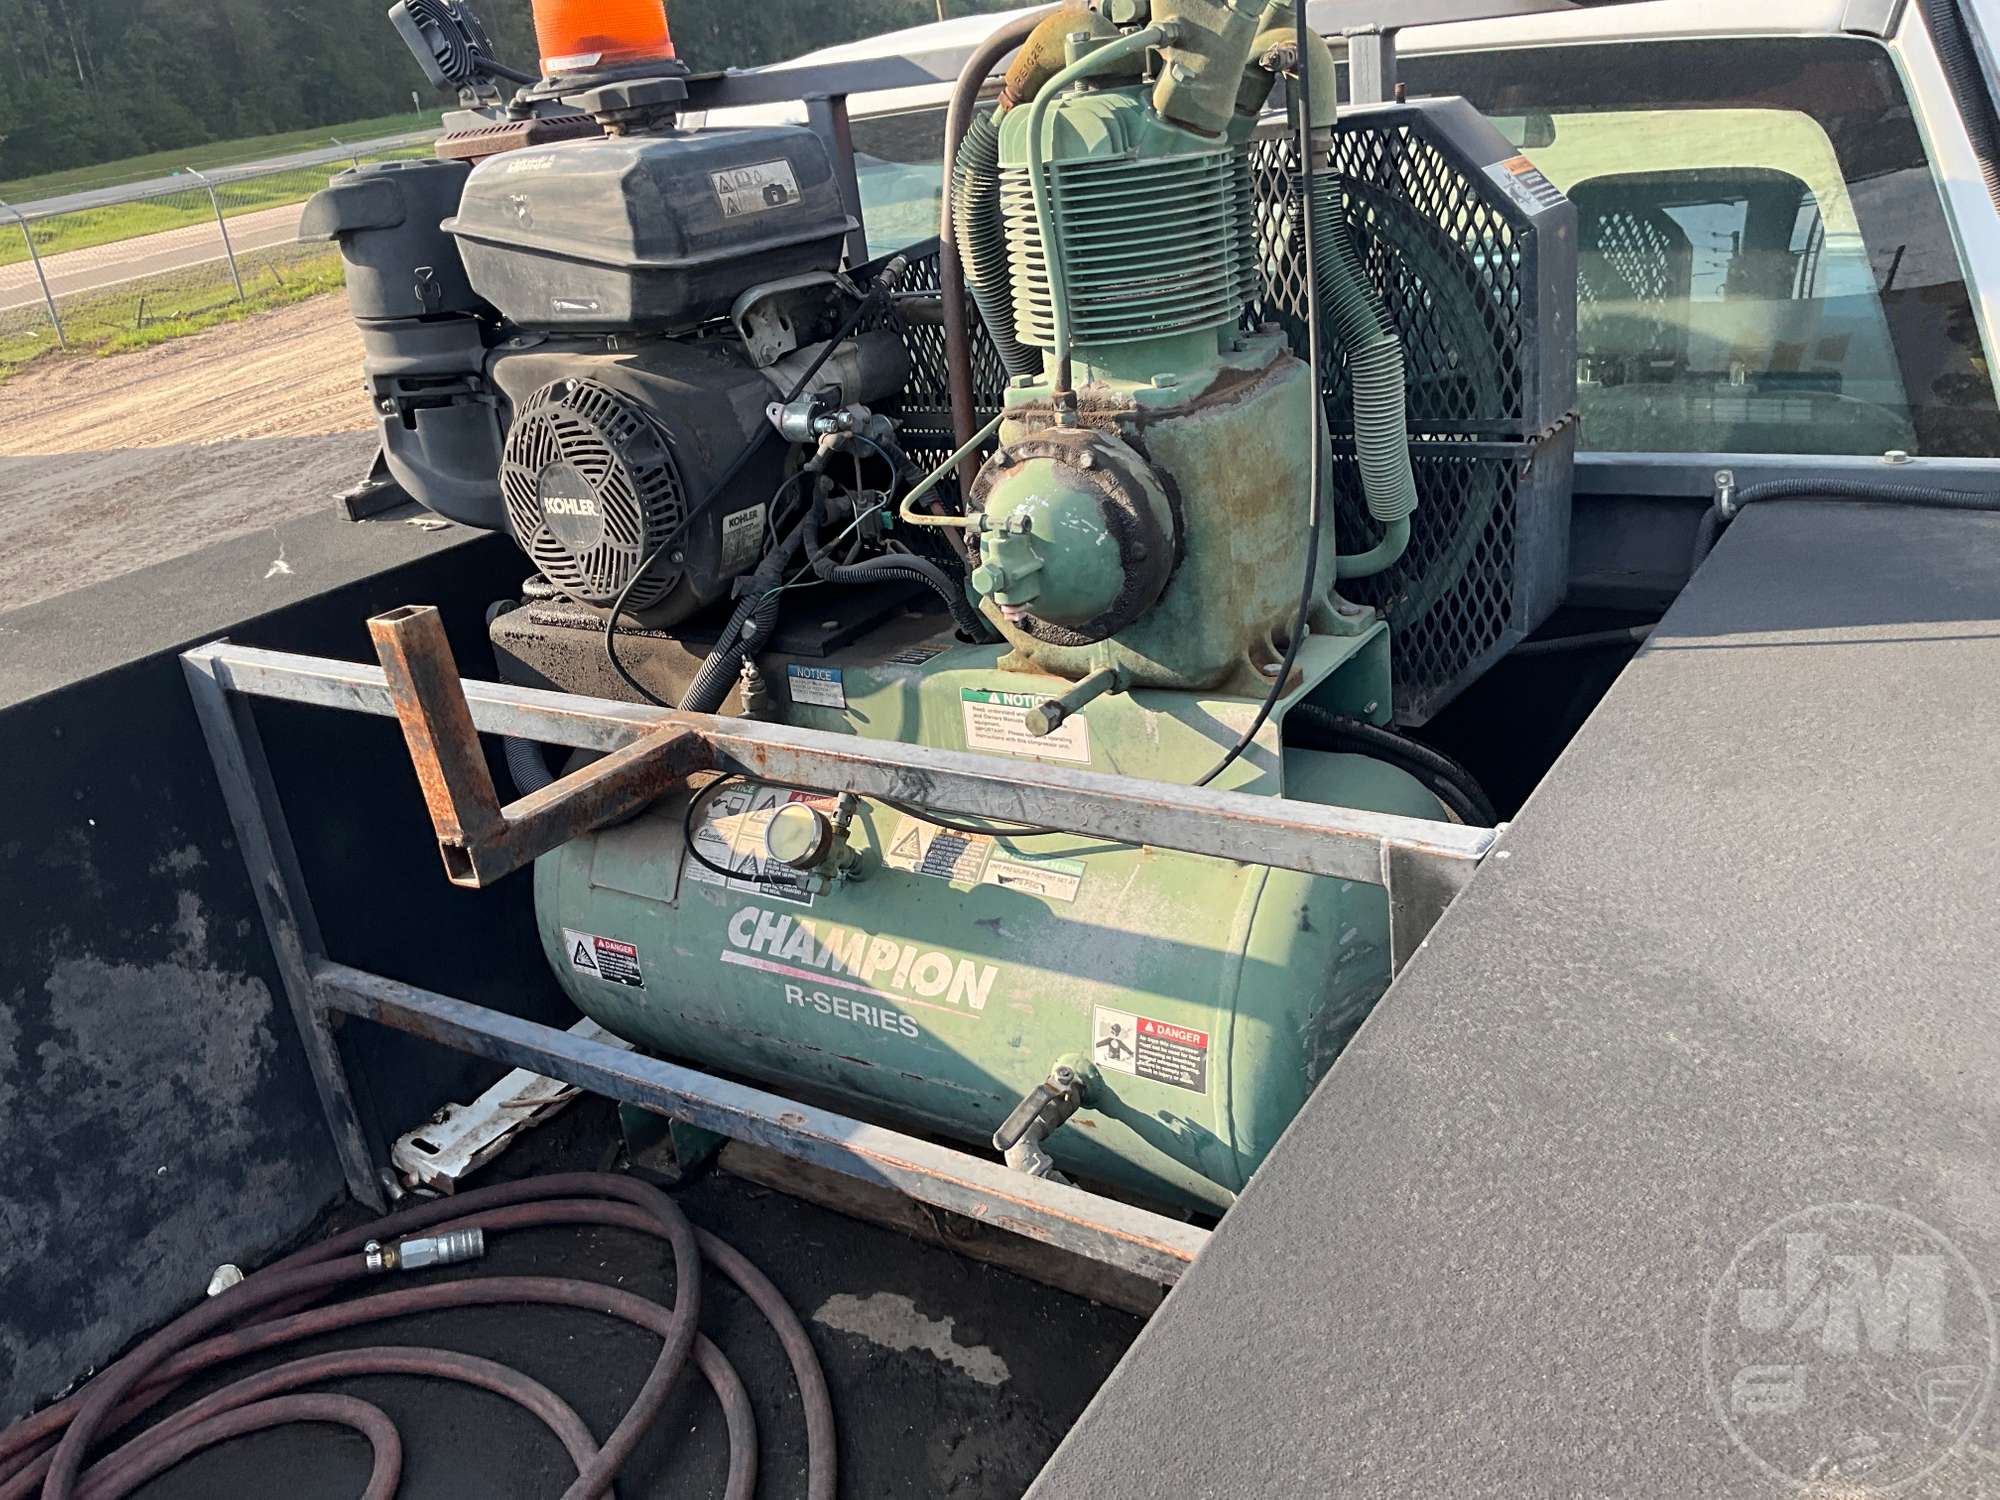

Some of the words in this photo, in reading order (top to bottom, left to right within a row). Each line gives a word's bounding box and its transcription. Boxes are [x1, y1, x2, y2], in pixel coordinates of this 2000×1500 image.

[543, 496, 600, 517] KOHLER
[728, 509, 758, 529] KOHLER
[797, 666, 832, 681] NOTICE
[605, 941, 633, 956] DANGER
[728, 906, 999, 1011] CHAMPION
[784, 983, 920, 1039] R-SERIES
[1157, 1025, 1201, 1044] DANGER
